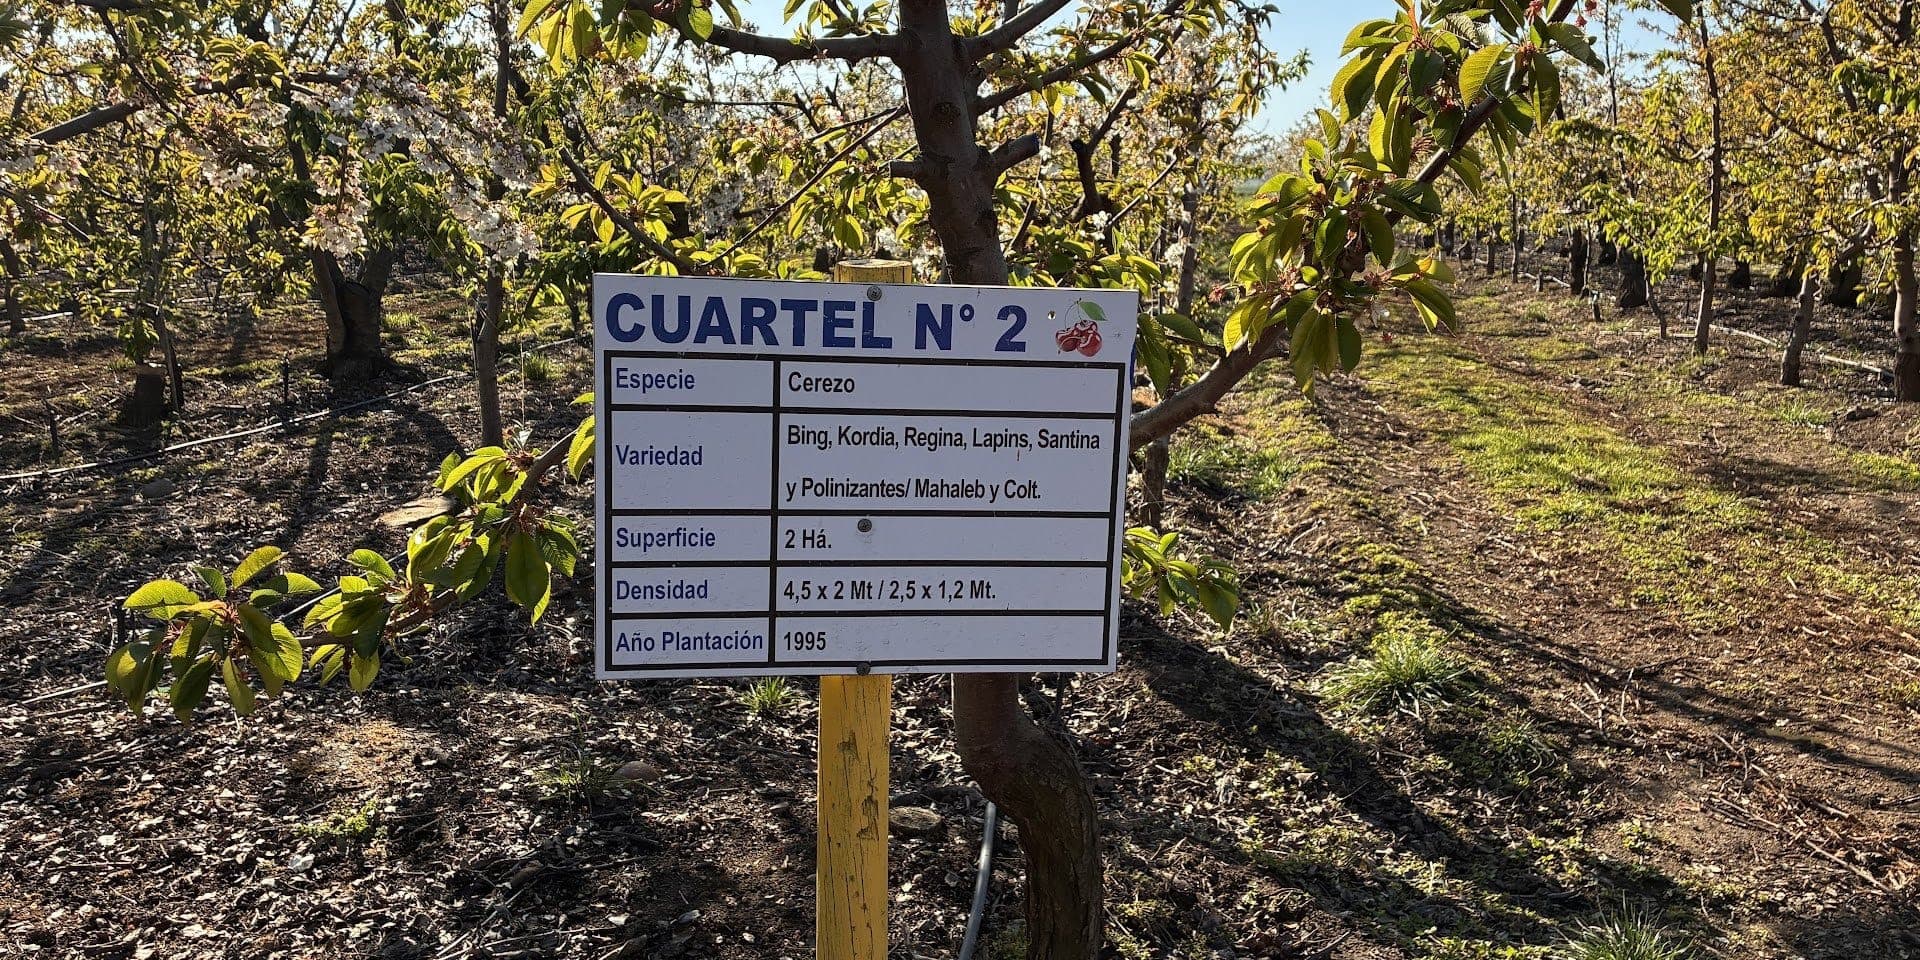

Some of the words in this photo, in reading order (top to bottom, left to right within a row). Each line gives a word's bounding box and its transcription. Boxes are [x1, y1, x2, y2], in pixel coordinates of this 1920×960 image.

[605, 293, 893, 349] CUARTEL
[994, 304, 1028, 353] 2
[615, 367, 696, 392] Especie
[788, 371, 856, 394] Cerezo
[787, 424, 833, 451] Bing,
[837, 425, 899, 450] Kordia,
[904, 426, 968, 452] Regina,
[972, 427, 1033, 453] Lapins,
[1037, 428, 1100, 450] Santina
[615, 444, 703, 466] Variedad
[785, 482, 796, 503] y
[801, 477, 912, 499] Polinizantes/
[914, 478, 986, 499] Mahaleb
[989, 484, 999, 504] y
[1003, 478, 1041, 500] Colt.
[615, 526, 716, 553] Superficie
[784, 528, 796, 549] 2
[802, 528, 832, 549] Há.
[616, 578, 708, 601] Densidad
[783, 580, 812, 604] 4,5
[816, 585, 828, 600] x
[833, 580, 844, 600] 2
[850, 580, 873, 600] Mt
[877, 579, 885, 600] /
[888, 580, 916, 604] 2,5
[921, 584, 932, 600] x
[938, 579, 964, 603] 1,2
[969, 579, 996, 600] Mt.
[615, 632, 656, 653] Año
[662, 629, 763, 652] Plantación
[783, 631, 827, 651] 1995
